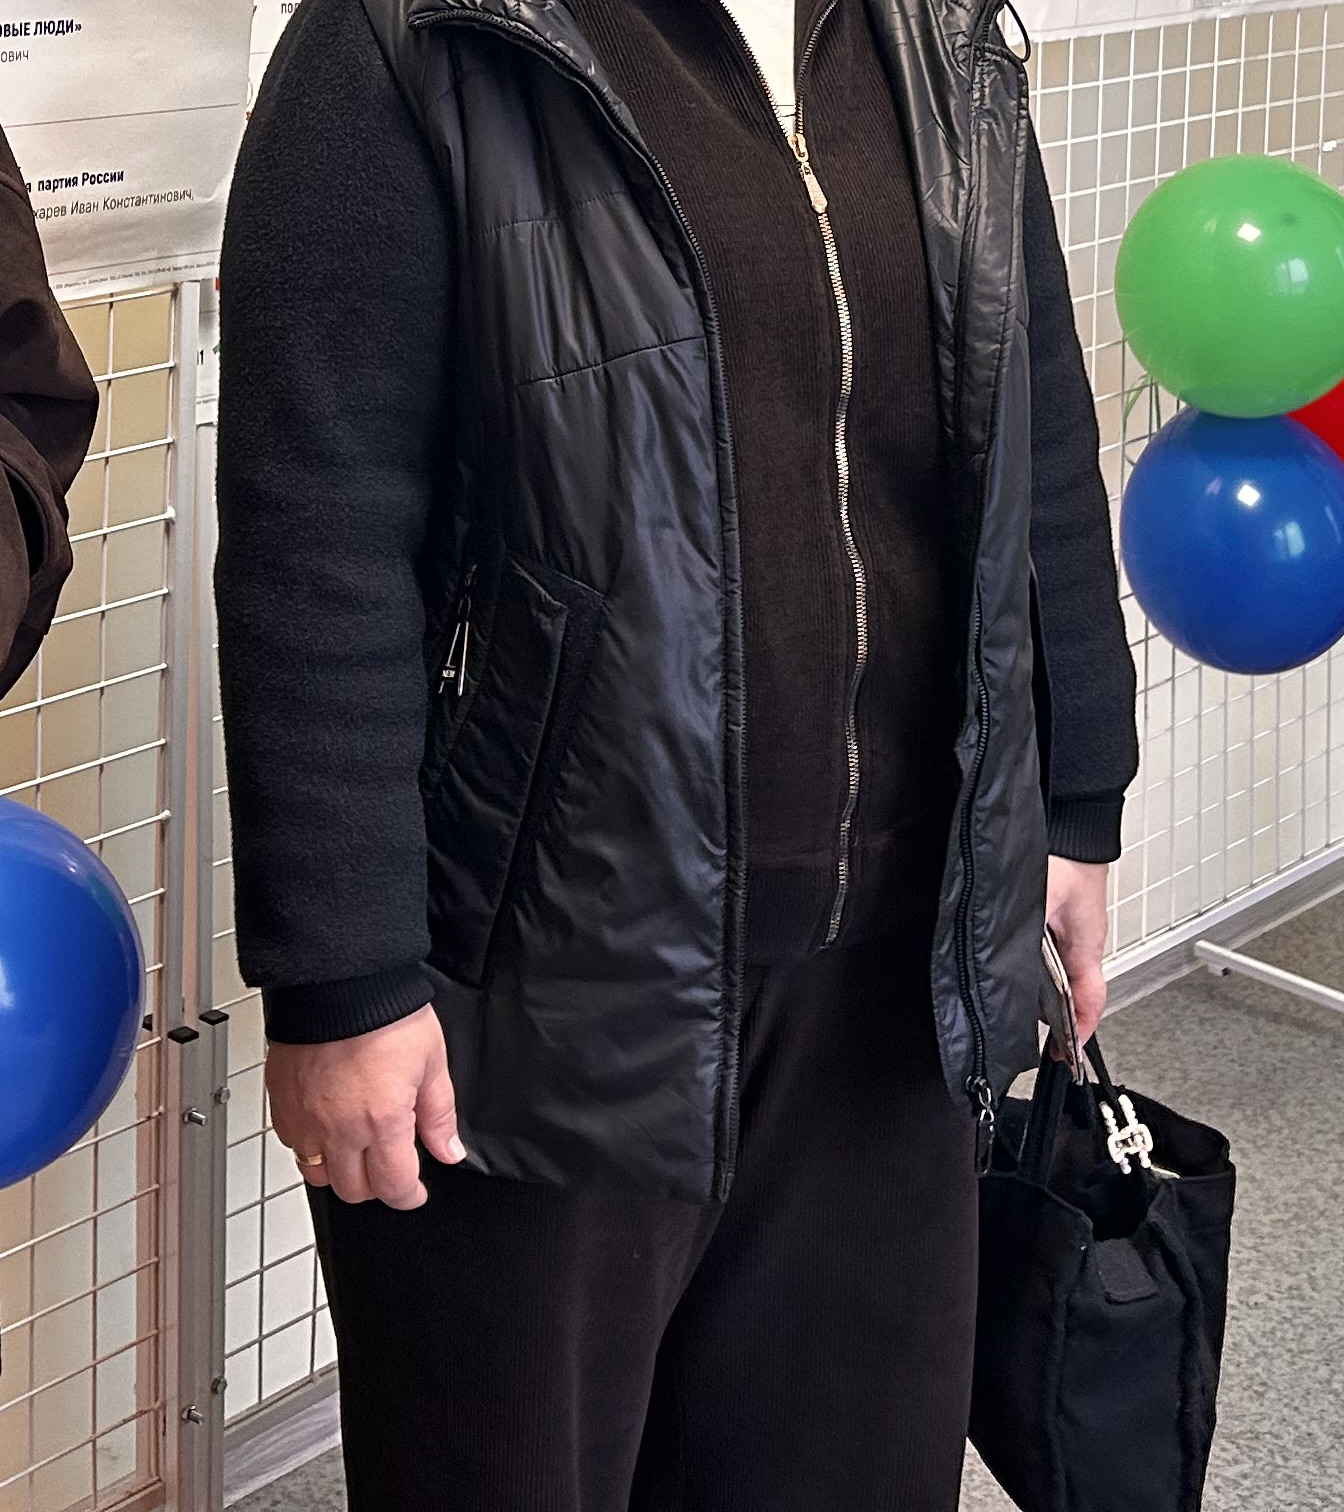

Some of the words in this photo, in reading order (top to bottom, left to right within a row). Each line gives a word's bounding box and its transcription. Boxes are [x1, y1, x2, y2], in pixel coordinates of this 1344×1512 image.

[34, 19, 82, 36] ЛЮДИ»
[37, 176, 78, 193] партия
[82, 171, 124, 187] России
[71, 200, 99, 215] Иван
[103, 188, 194, 211] Константинович,
